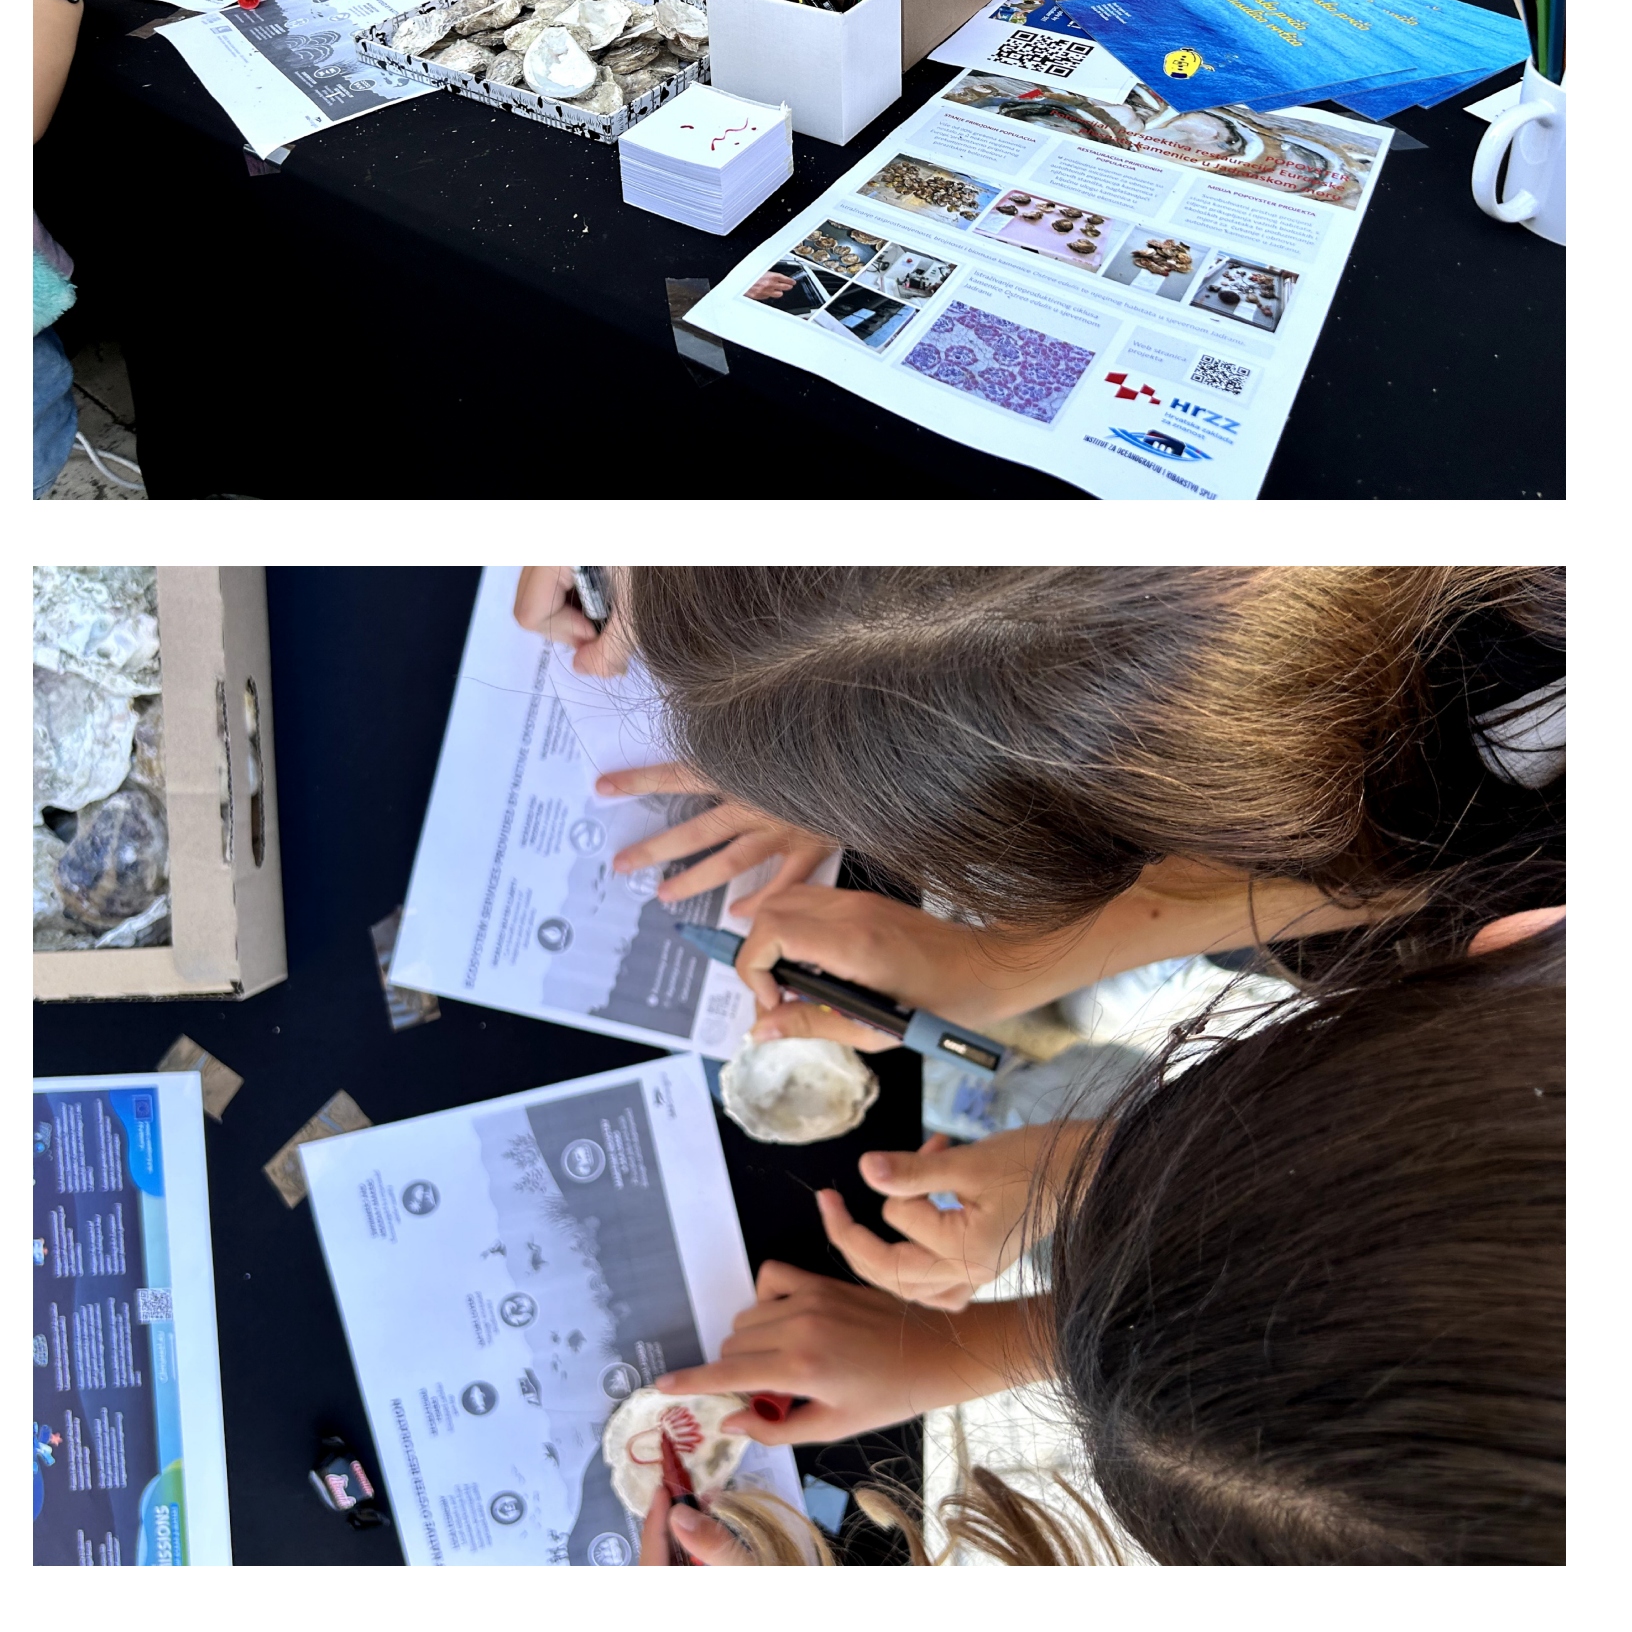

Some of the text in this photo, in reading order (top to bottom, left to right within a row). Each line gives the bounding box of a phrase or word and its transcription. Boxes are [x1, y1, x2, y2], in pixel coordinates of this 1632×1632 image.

[1118, 126, 1193, 153] perspektiva
[1194, 146, 1275, 175] restauracije
[1278, 168, 1345, 194] Europske
[1135, 140, 1198, 164] kamenice
[1212, 161, 1297, 191] Jadranskom
[1300, 184, 1342, 202] moru
[1277, 202, 1316, 217] PROJEKTA
[968, 276, 1004, 294] kamenice
[1059, 309, 1101, 328] sjevernom
[998, 257, 1032, 274] kamenice
[1032, 271, 1057, 284] Ostrea
[1123, 301, 1157, 318] habitata
[1165, 315, 1209, 334] sjevernom
[1072, 305, 1099, 320] ciklusa
[1127, 347, 1164, 364] projekta
[1132, 340, 1188, 363] Web stranica
[1082, 434, 1110, 450] INSTITUT
[1160, 417, 1207, 442] za znanost
[1164, 411, 1235, 446] Hrvatska zaklada
[490, 806, 517, 865] PROVIDED
[477, 865, 504, 920] SERVICES
[461, 919, 491, 989] ECOSYSTEM
[154, 1503, 172, 1566] ISSIONS
